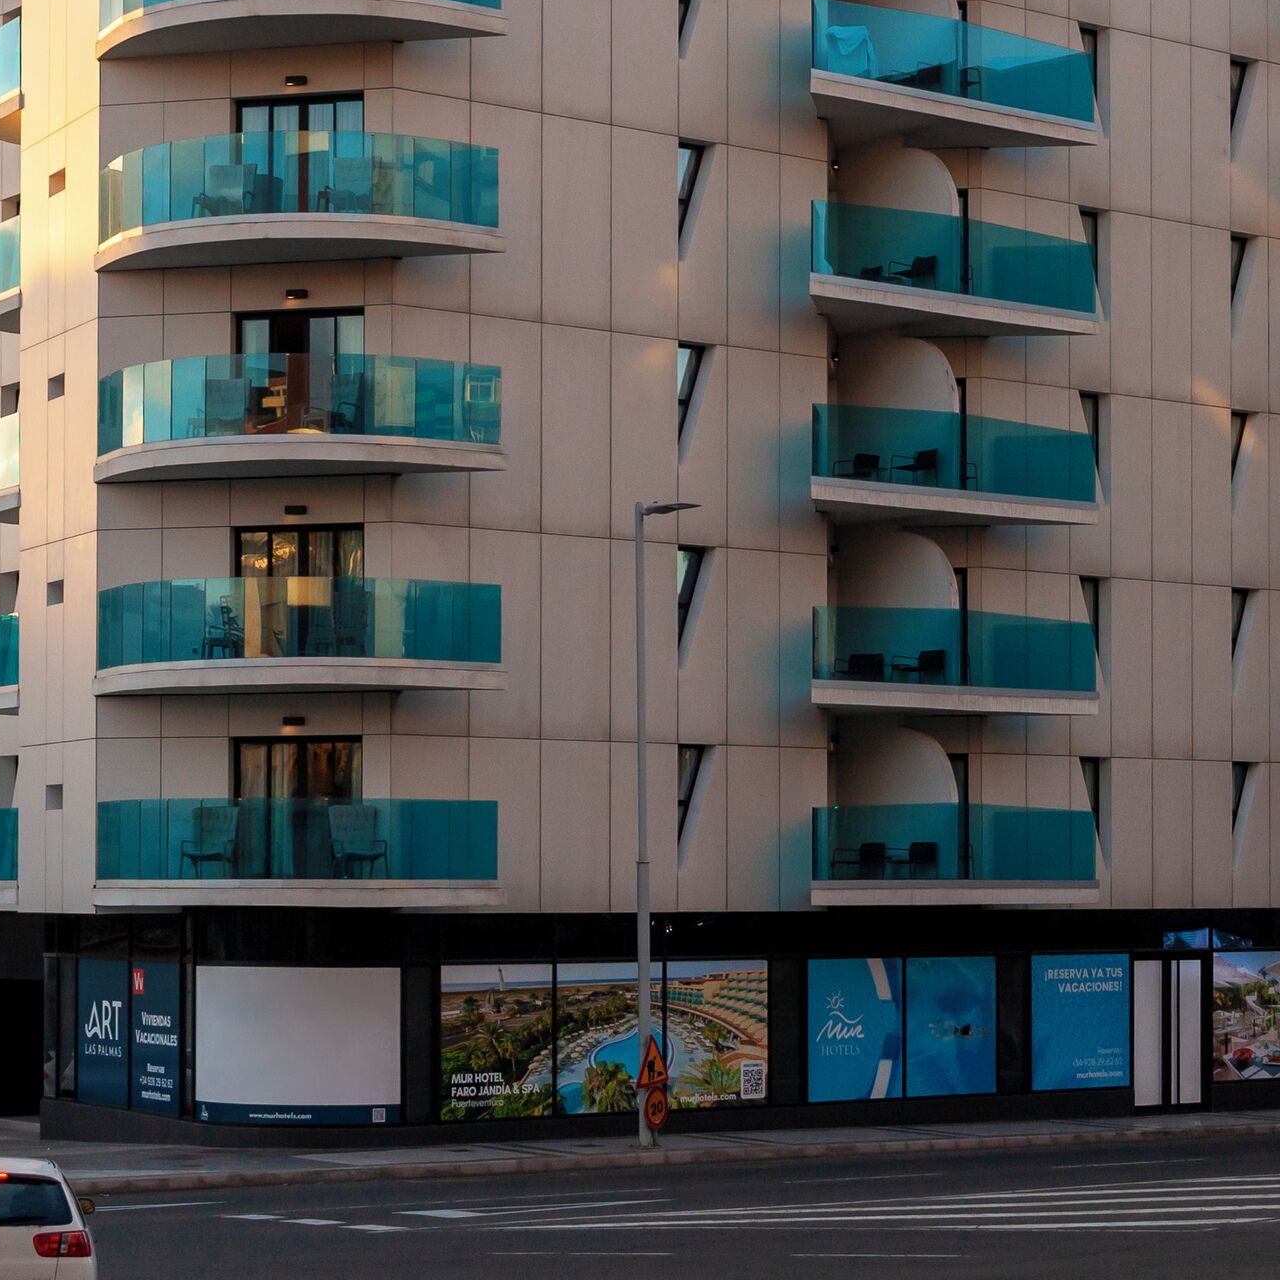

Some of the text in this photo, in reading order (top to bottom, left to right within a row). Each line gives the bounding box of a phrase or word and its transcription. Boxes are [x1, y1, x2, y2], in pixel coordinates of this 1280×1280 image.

[1044, 967, 1123, 982] ¡RESERVA YA TUS
[1058, 981, 1123, 993] VACACIONES!
[85, 1000, 122, 1041] ART
[85, 1043, 122, 1058] LAS PALMAS
[821, 1044, 861, 1056] HOTELS
[451, 1072, 504, 1084] MUR HOTEL
[451, 1082, 540, 1097] FARO JANDÍA & SPA
[451, 1098, 504, 1108] Fuerteventura
[680, 1092, 737, 1104] murhotels.com
[650, 1100, 664, 1116] 20
[248, 1111, 312, 1119] www.murhotels.com
